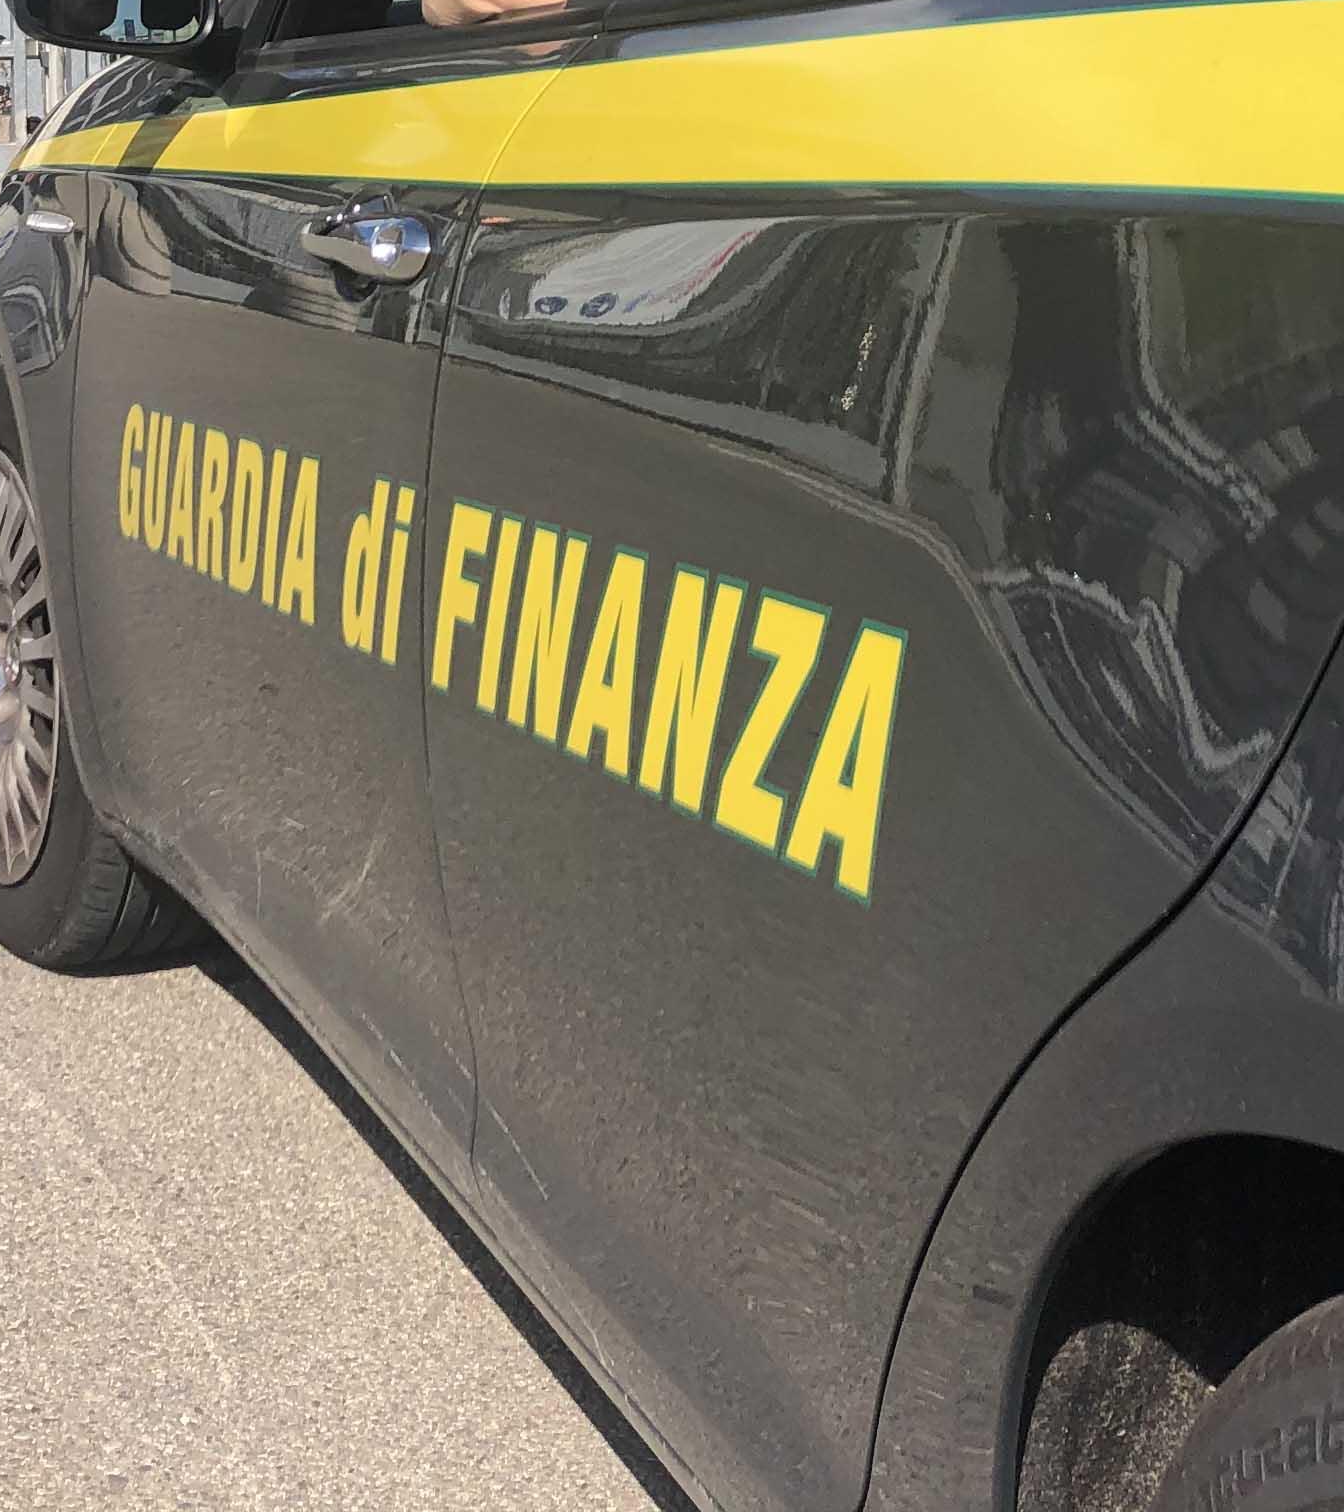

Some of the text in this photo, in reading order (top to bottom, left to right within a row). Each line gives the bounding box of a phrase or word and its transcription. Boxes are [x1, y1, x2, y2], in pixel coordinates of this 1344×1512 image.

[118, 403, 909, 906] GUARDIA di FINANZA
